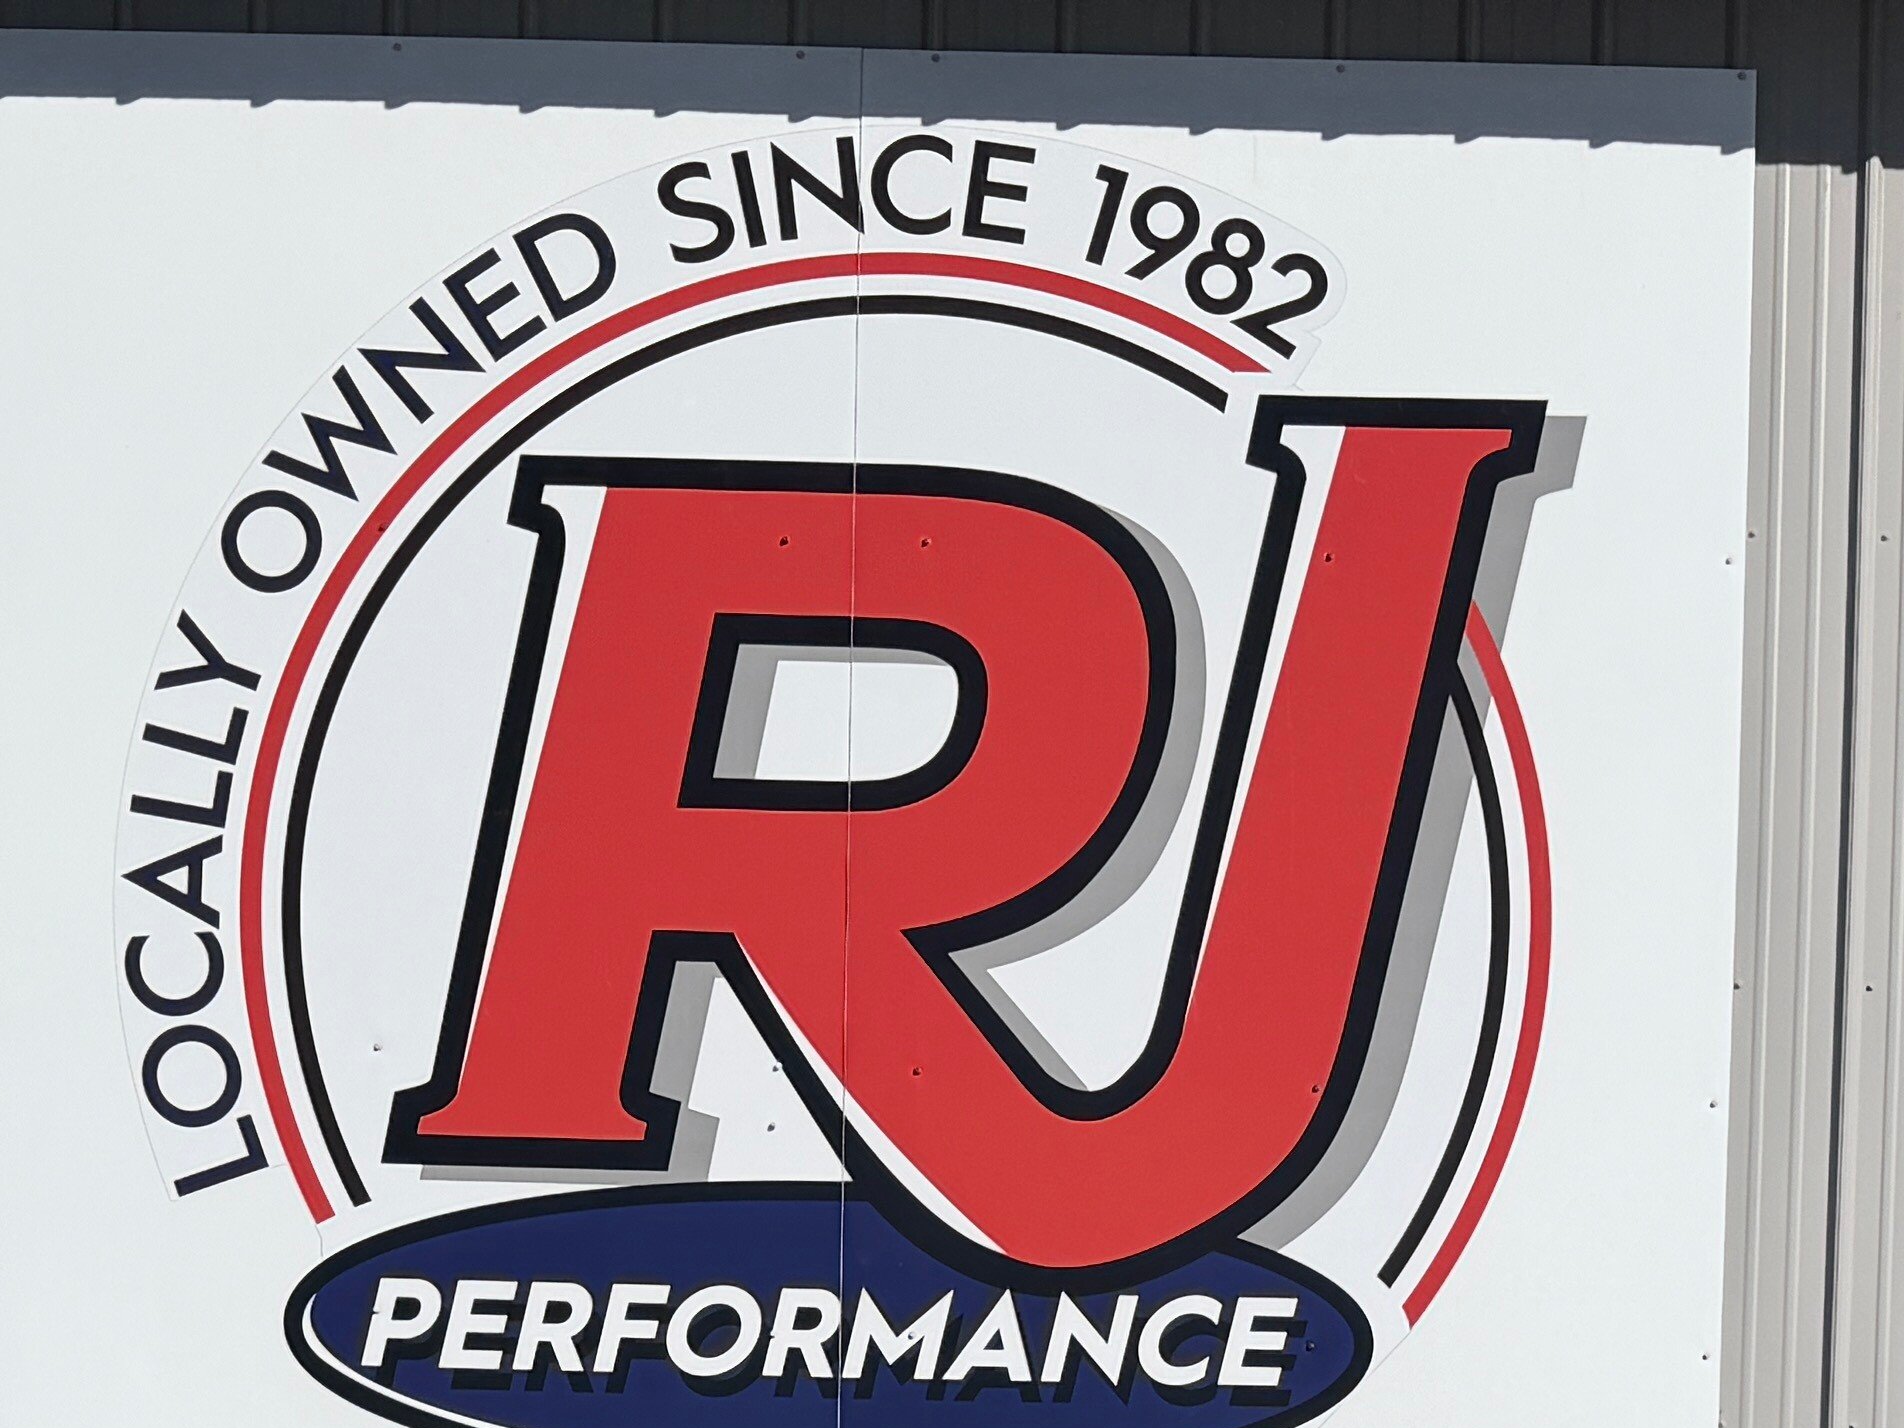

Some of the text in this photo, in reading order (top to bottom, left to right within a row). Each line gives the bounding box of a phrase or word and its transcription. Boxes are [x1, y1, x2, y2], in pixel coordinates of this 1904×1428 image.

[123, 134, 1331, 1198] LOCALLY OWNED SINCE 1982
[382, 395, 1549, 1291] RJ
[360, 1277, 1299, 1388] PERFORMANCE
